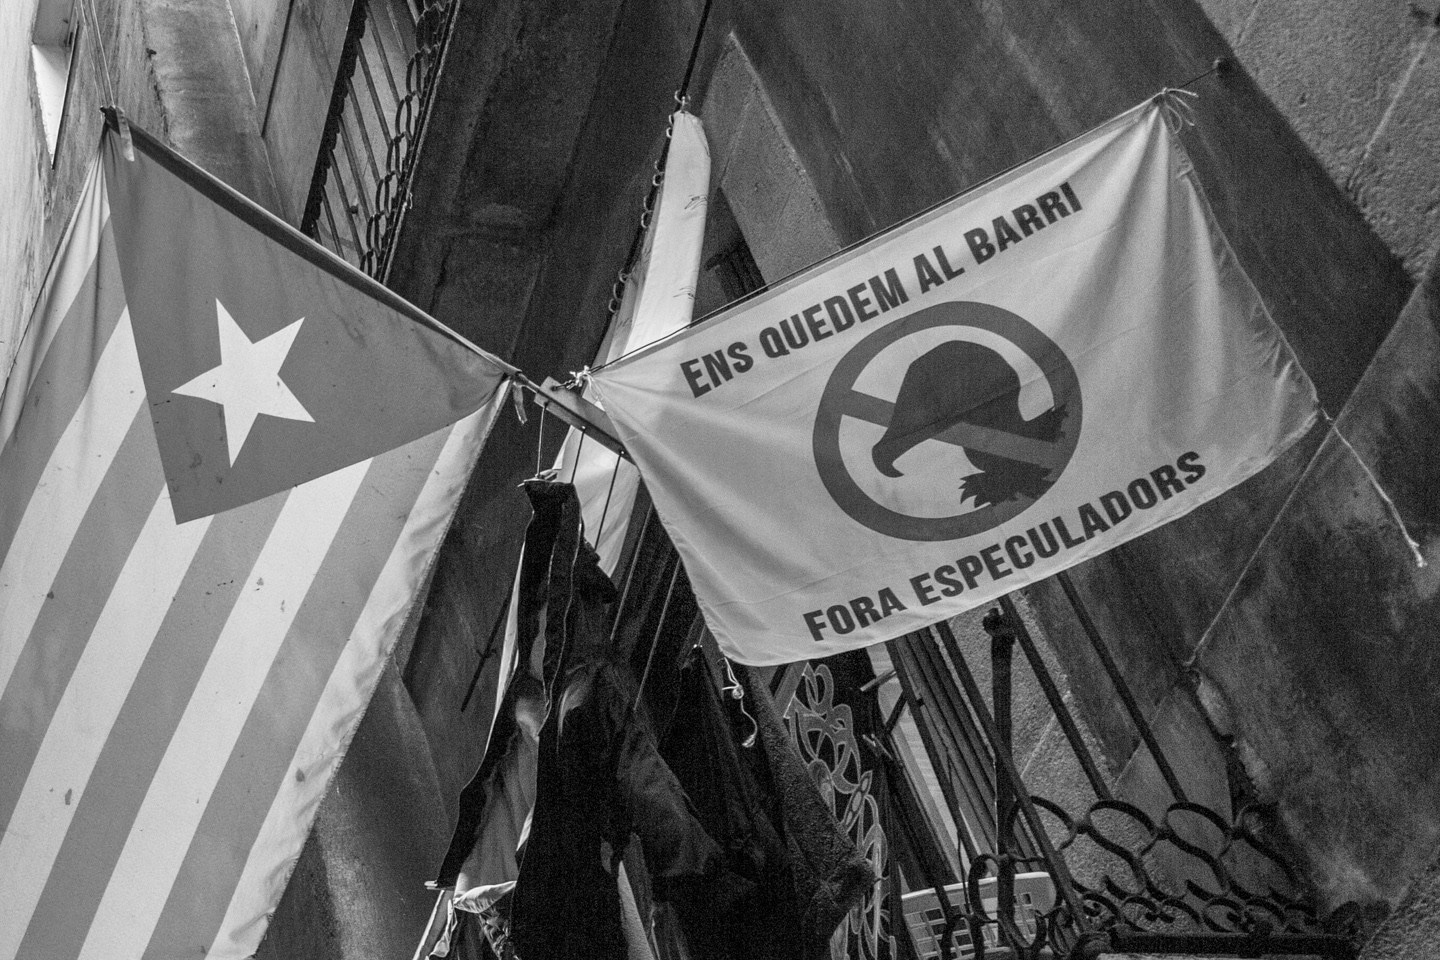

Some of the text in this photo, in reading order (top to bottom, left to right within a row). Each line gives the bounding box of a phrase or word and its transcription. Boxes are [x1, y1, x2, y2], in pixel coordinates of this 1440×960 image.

[680, 180, 1082, 399] ENS QUEDEM AL BARRI
[803, 450, 1206, 641] FORA ESPECULADORS
